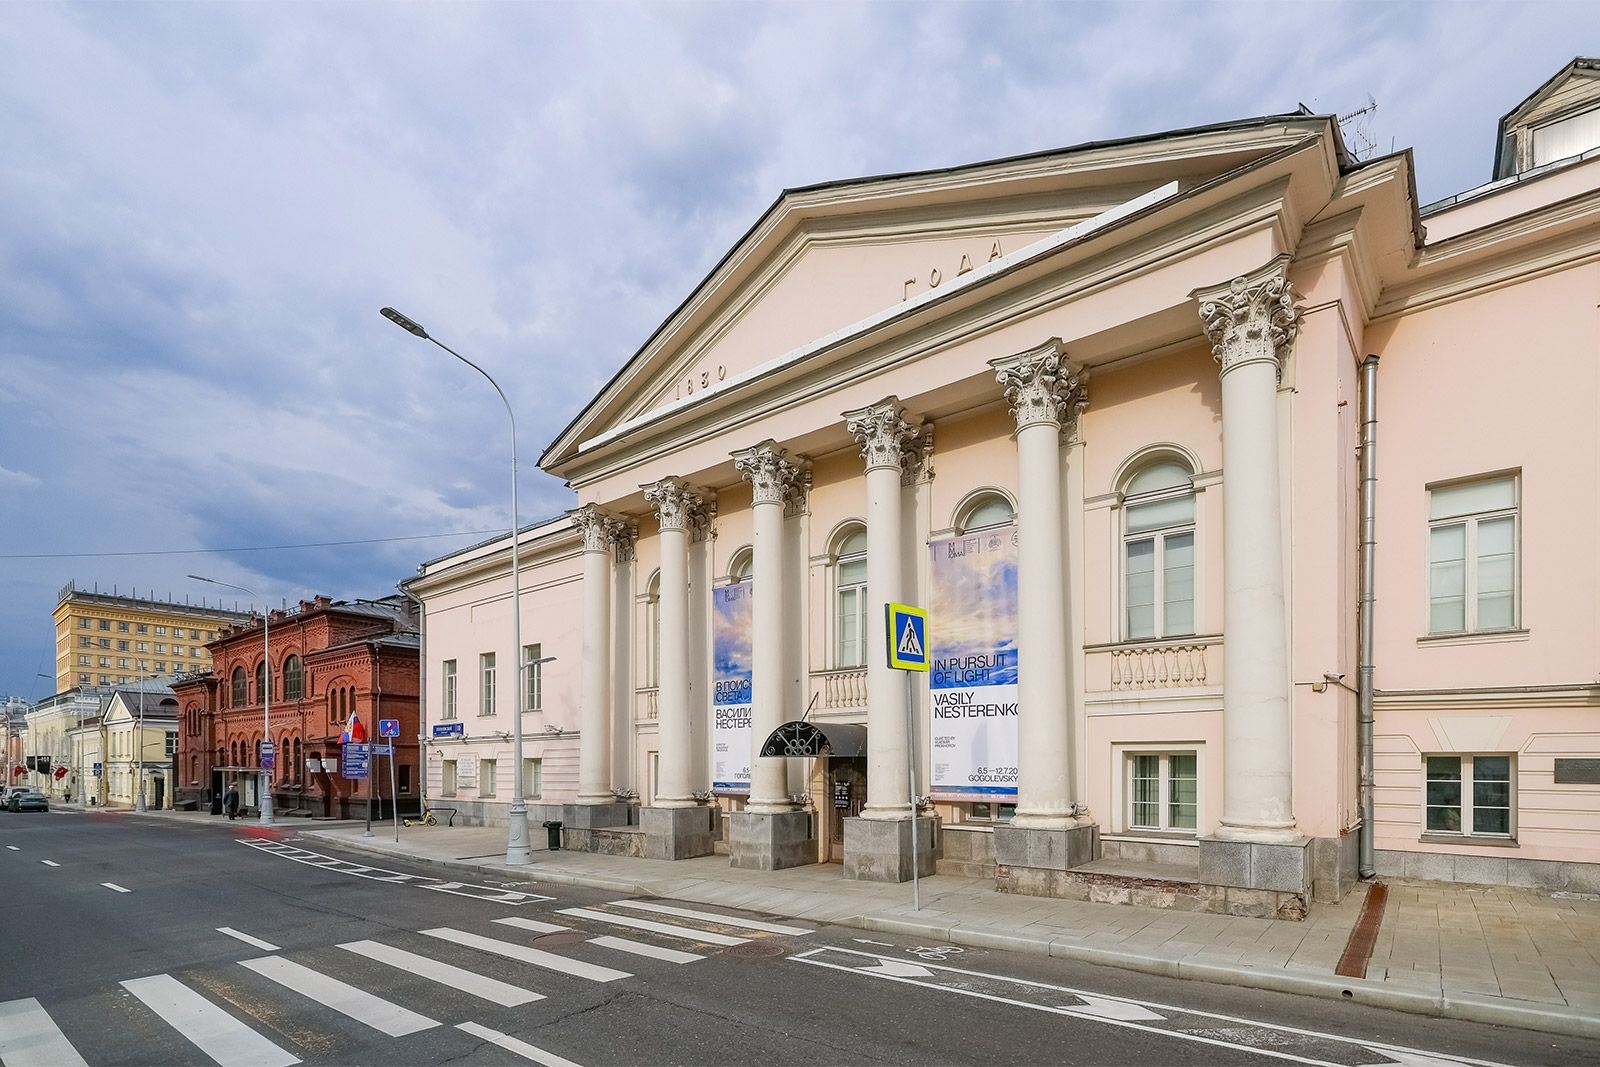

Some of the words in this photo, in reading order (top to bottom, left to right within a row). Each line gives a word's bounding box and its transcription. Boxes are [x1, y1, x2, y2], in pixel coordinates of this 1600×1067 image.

[902, 239, 1003, 301] ГОДА
[934, 659, 947, 672] IN
[949, 653, 1008, 670] PURSUIT
[934, 671, 951, 685] OF
[954, 668, 991, 683] LIGHT
[716, 681, 722, 692] В
[716, 690, 744, 702] СВЕТА
[934, 692, 975, 706] VASILY
